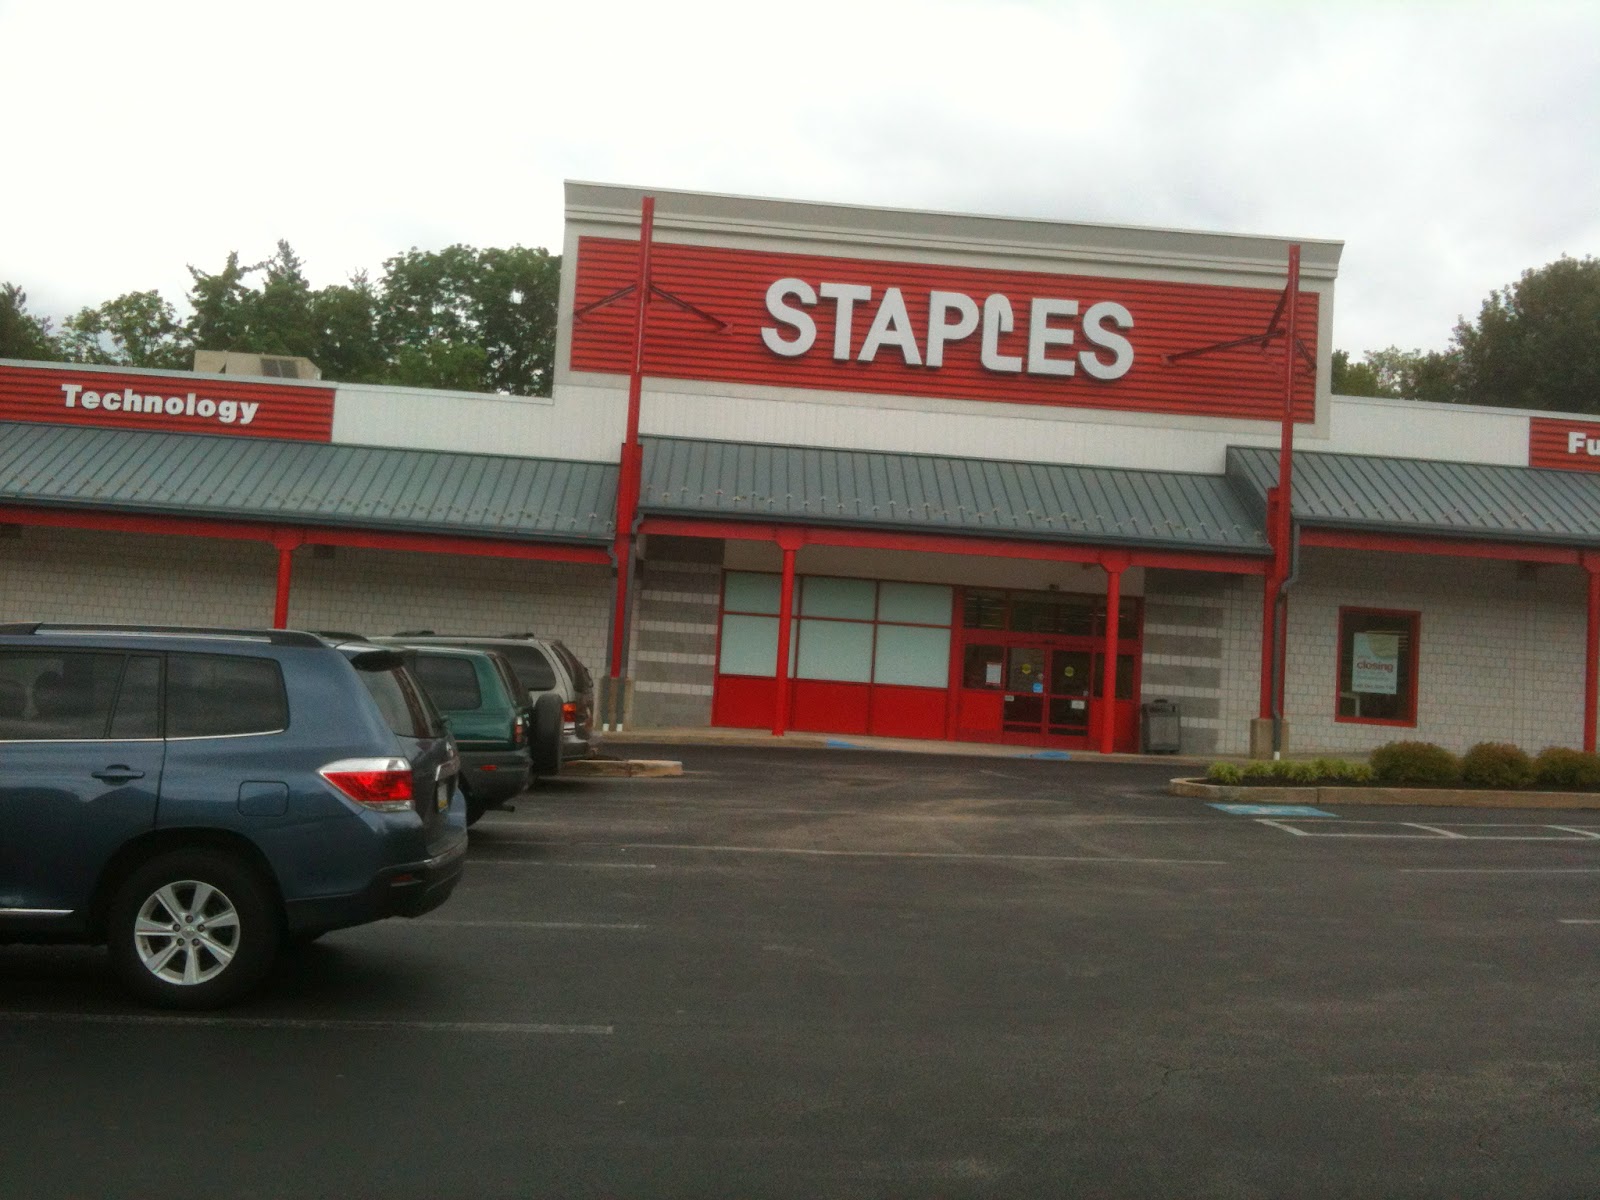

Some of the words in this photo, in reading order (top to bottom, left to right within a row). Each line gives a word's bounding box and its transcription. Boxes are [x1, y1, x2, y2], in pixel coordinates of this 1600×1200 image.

[760, 277, 1134, 380] STAPLES
[61, 384, 259, 424] Technology
[1568, 432, 1600, 455] Fu
[1357, 660, 1394, 673] closing
